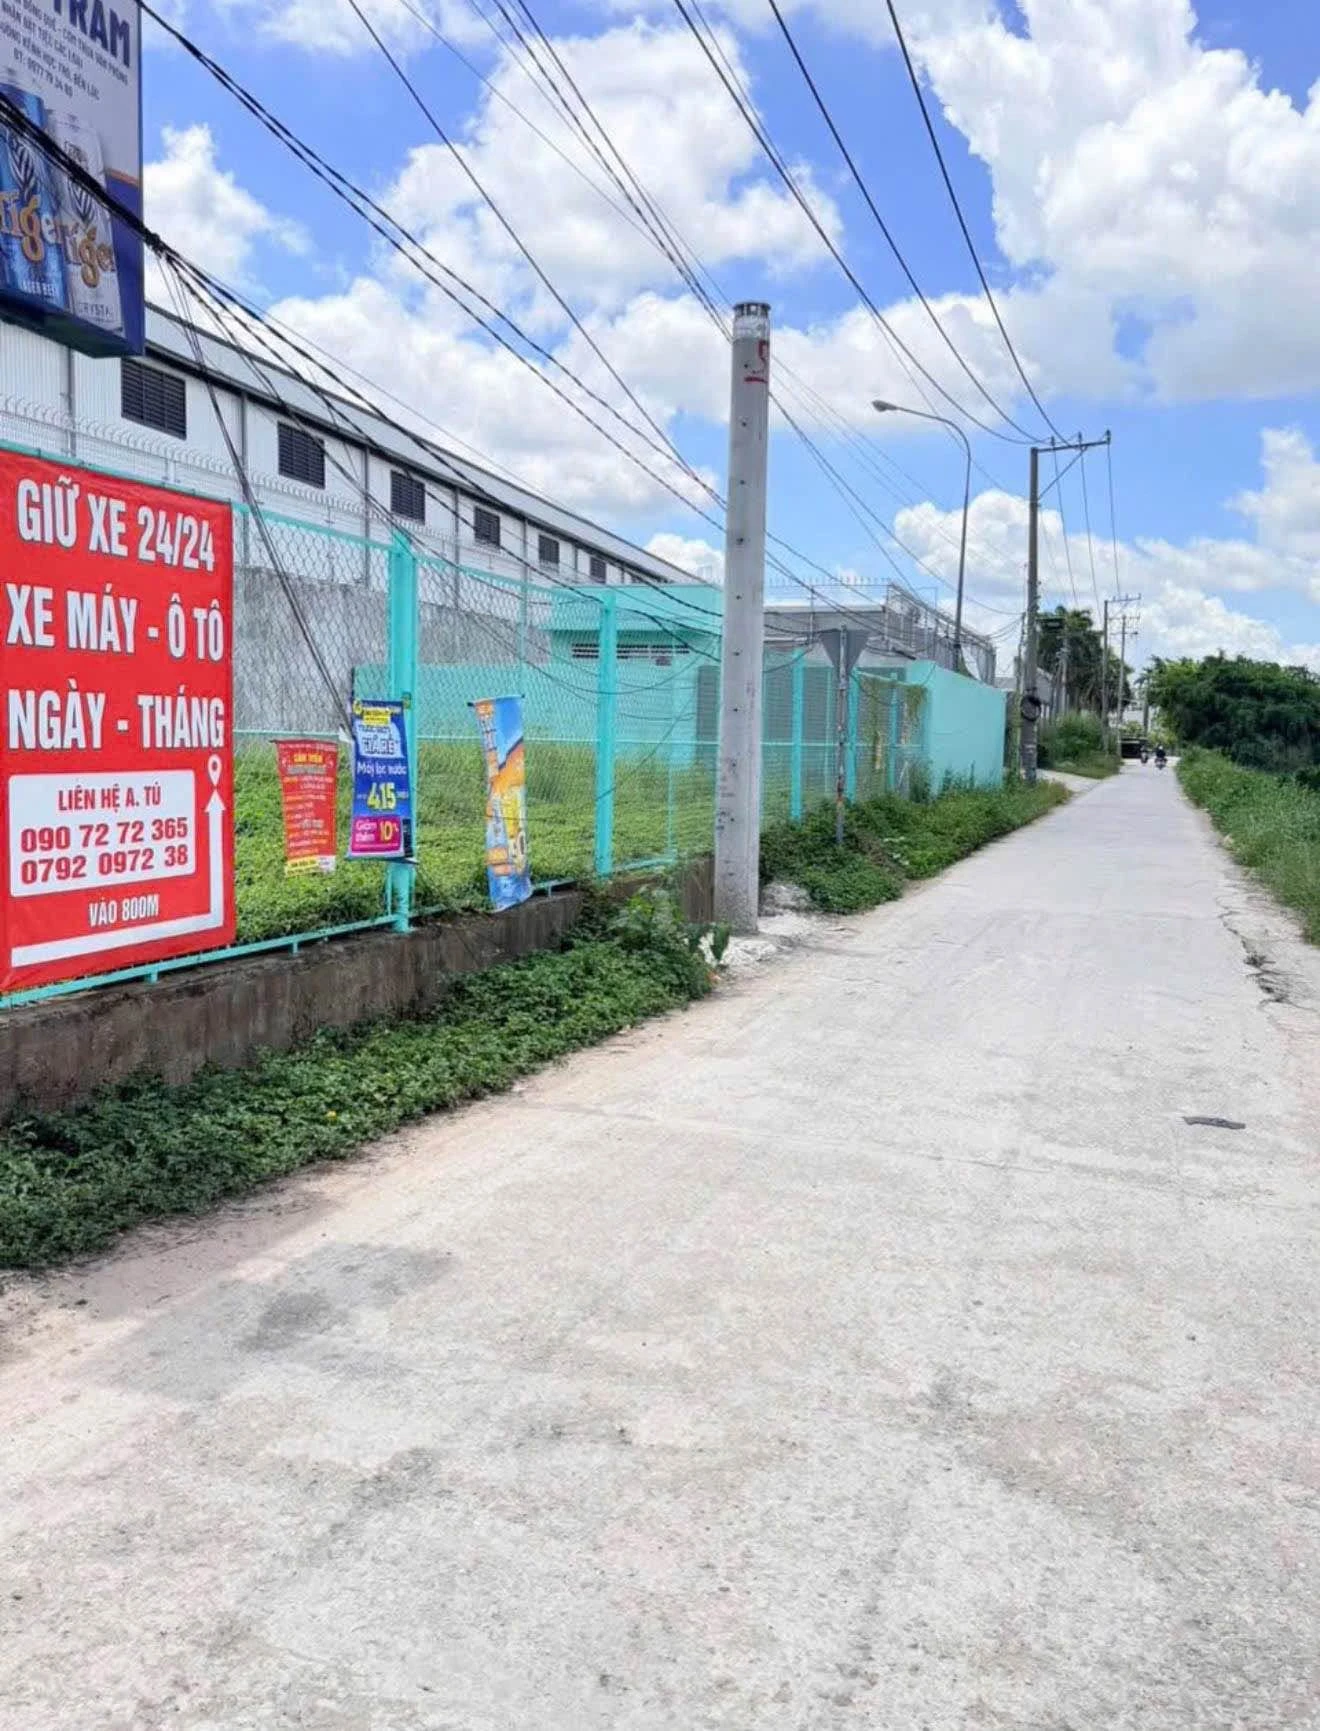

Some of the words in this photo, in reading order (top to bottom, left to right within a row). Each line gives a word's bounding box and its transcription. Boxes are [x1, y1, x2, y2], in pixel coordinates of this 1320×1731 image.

[17, 474, 80, 548] GIỮ
[87, 493, 128, 557] XE
[137, 506, 215, 572] 24/24
[6, 582, 55, 647] XE
[66, 583, 138, 653] MÁY
[168, 592, 186, 659] Ô
[193, 599, 224, 661] TÔ
[8, 678, 106, 749] NGÀY
[137, 684, 225, 748] THÁNG
[58, 784, 96, 811] LIÊN
[101, 783, 121, 813] HỆ
[125, 791, 140, 808] A.
[21, 826, 70, 852] 090
[79, 823, 109, 848] 72
[117, 820, 144, 844] 72
[152, 816, 188, 841] 365
[21, 855, 87, 885] 0792
[98, 848, 154, 876] 0972
[164, 844, 188, 867] 38
[122, 894, 159, 921] 800M
